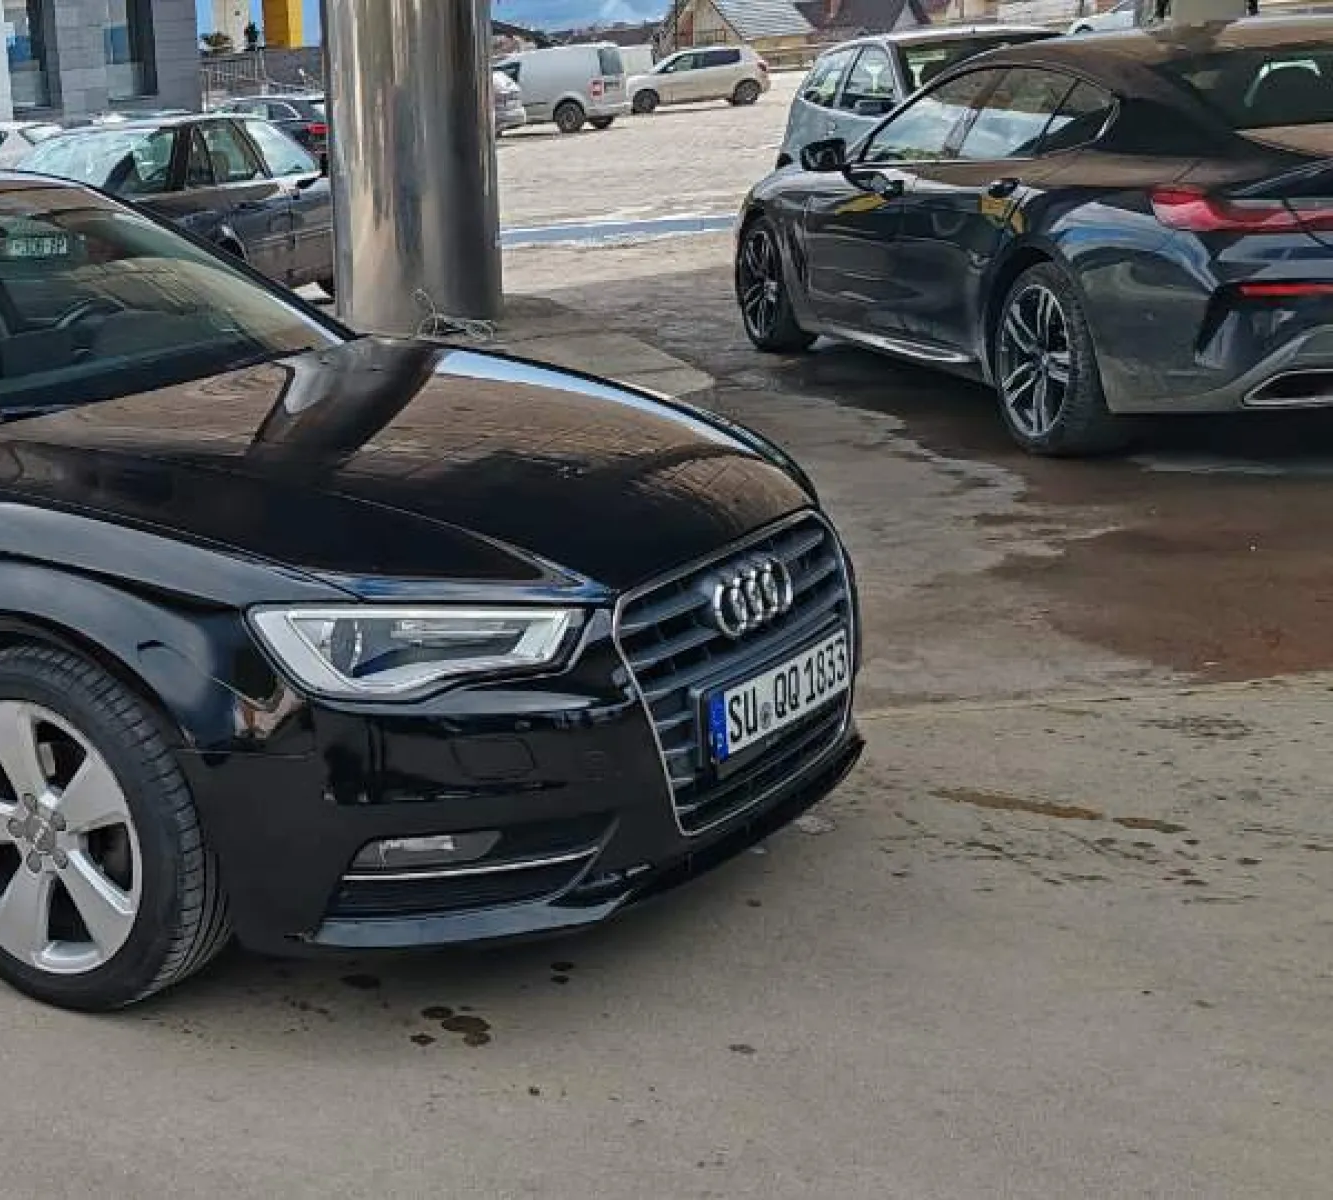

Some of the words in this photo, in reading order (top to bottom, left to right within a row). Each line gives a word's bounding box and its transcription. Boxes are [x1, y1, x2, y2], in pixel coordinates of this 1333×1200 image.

[729, 687, 758, 743] SU
[774, 667, 800, 719] QQ
[804, 638, 845, 702] 1833
